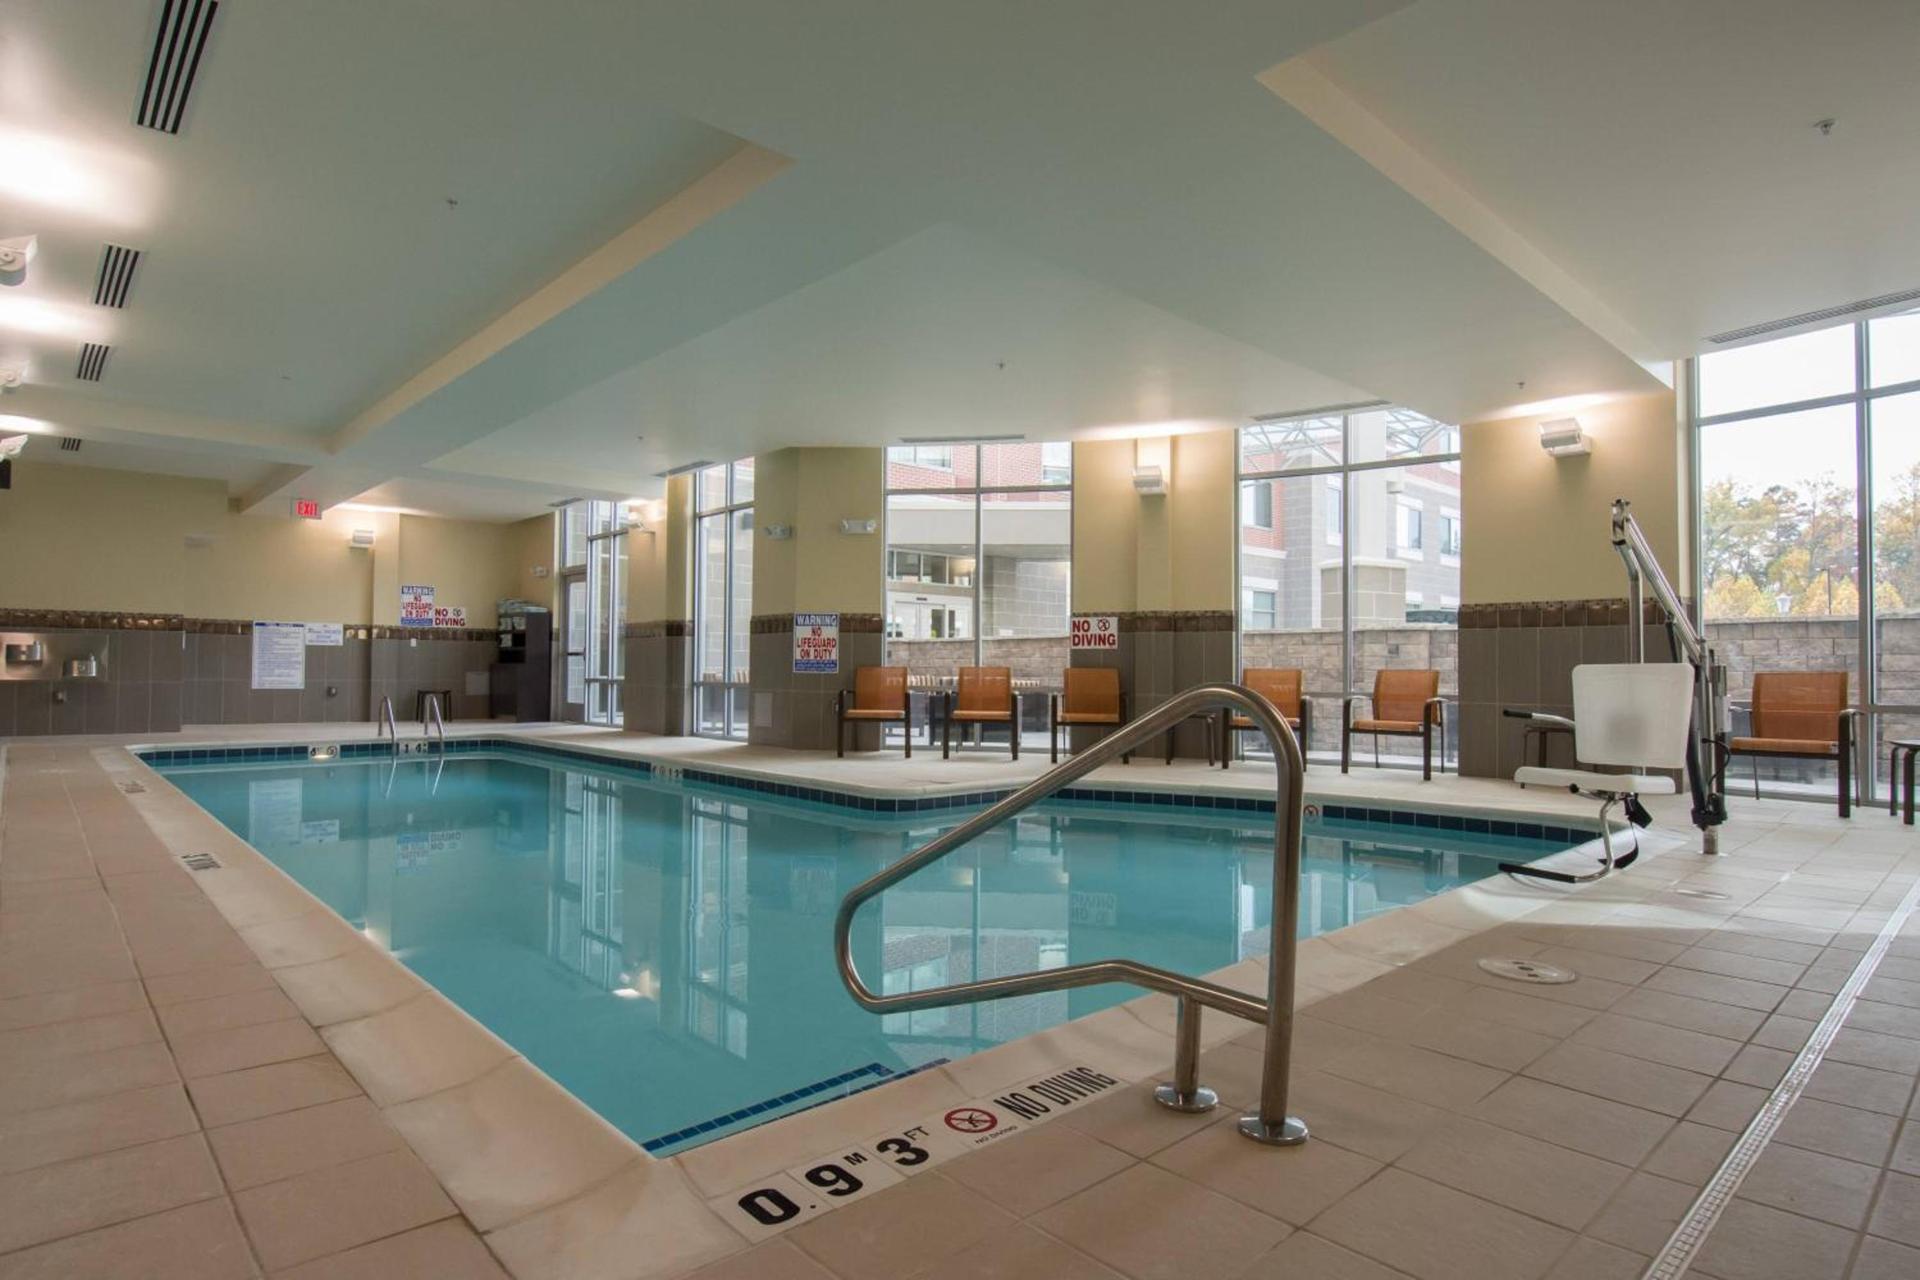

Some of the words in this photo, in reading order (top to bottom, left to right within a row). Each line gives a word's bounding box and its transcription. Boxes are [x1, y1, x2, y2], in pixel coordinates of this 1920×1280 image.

[297, 502, 318, 515] EXIT
[435, 608, 448, 617] NO
[435, 618, 465, 626] DIVING
[796, 615, 837, 625] WARNING
[1072, 620, 1090, 632] NO
[812, 627, 822, 637] NO
[797, 638, 837, 648] LIFEGUARD
[1072, 633, 1116, 646] DIVING
[800, 649, 810, 659] ON
[814, 649, 832, 659] DUTY
[993, 1093, 1051, 1120] NO
[1027, 1067, 1118, 1105] DIVING
[876, 1138, 929, 1166] 3
[903, 1126, 930, 1141] FT
